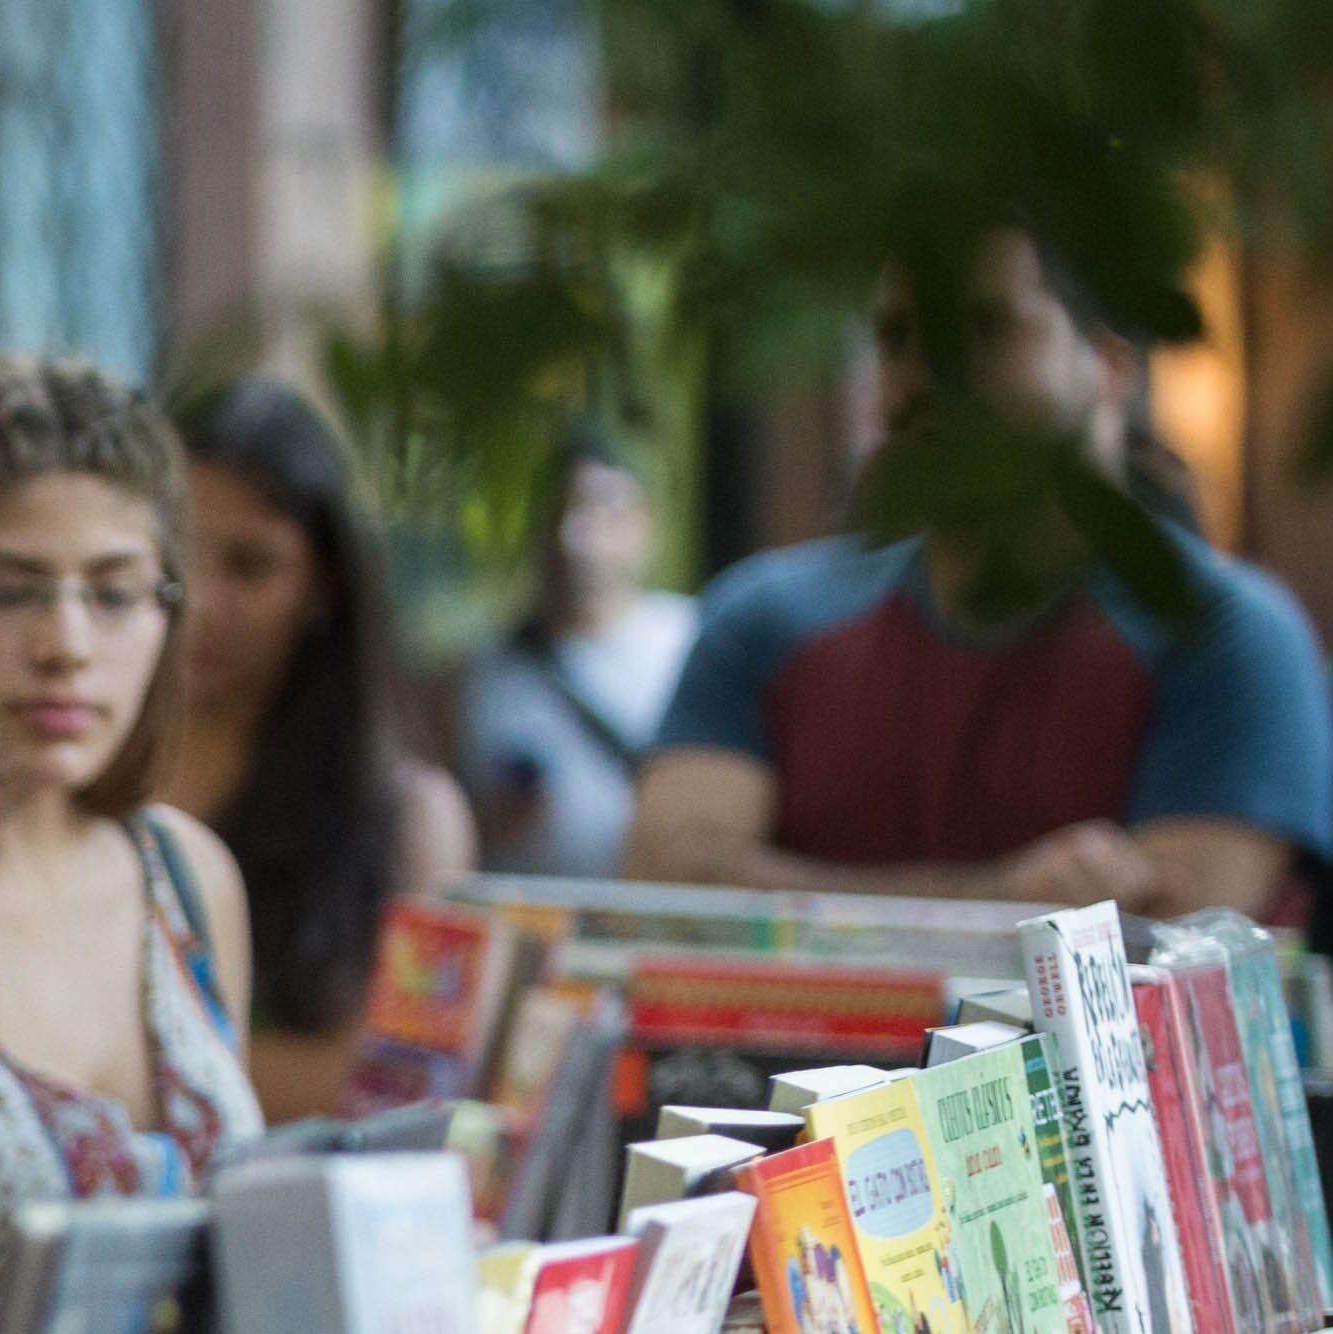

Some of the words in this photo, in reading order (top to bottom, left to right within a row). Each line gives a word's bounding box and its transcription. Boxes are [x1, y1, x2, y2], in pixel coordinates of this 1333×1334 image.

[1035, 955, 1053, 1018] GEORGE
[1048, 953, 1066, 1016] ORWELL
[1079, 1156, 1096, 1178] LA
[1083, 1184, 1100, 1204] EN
